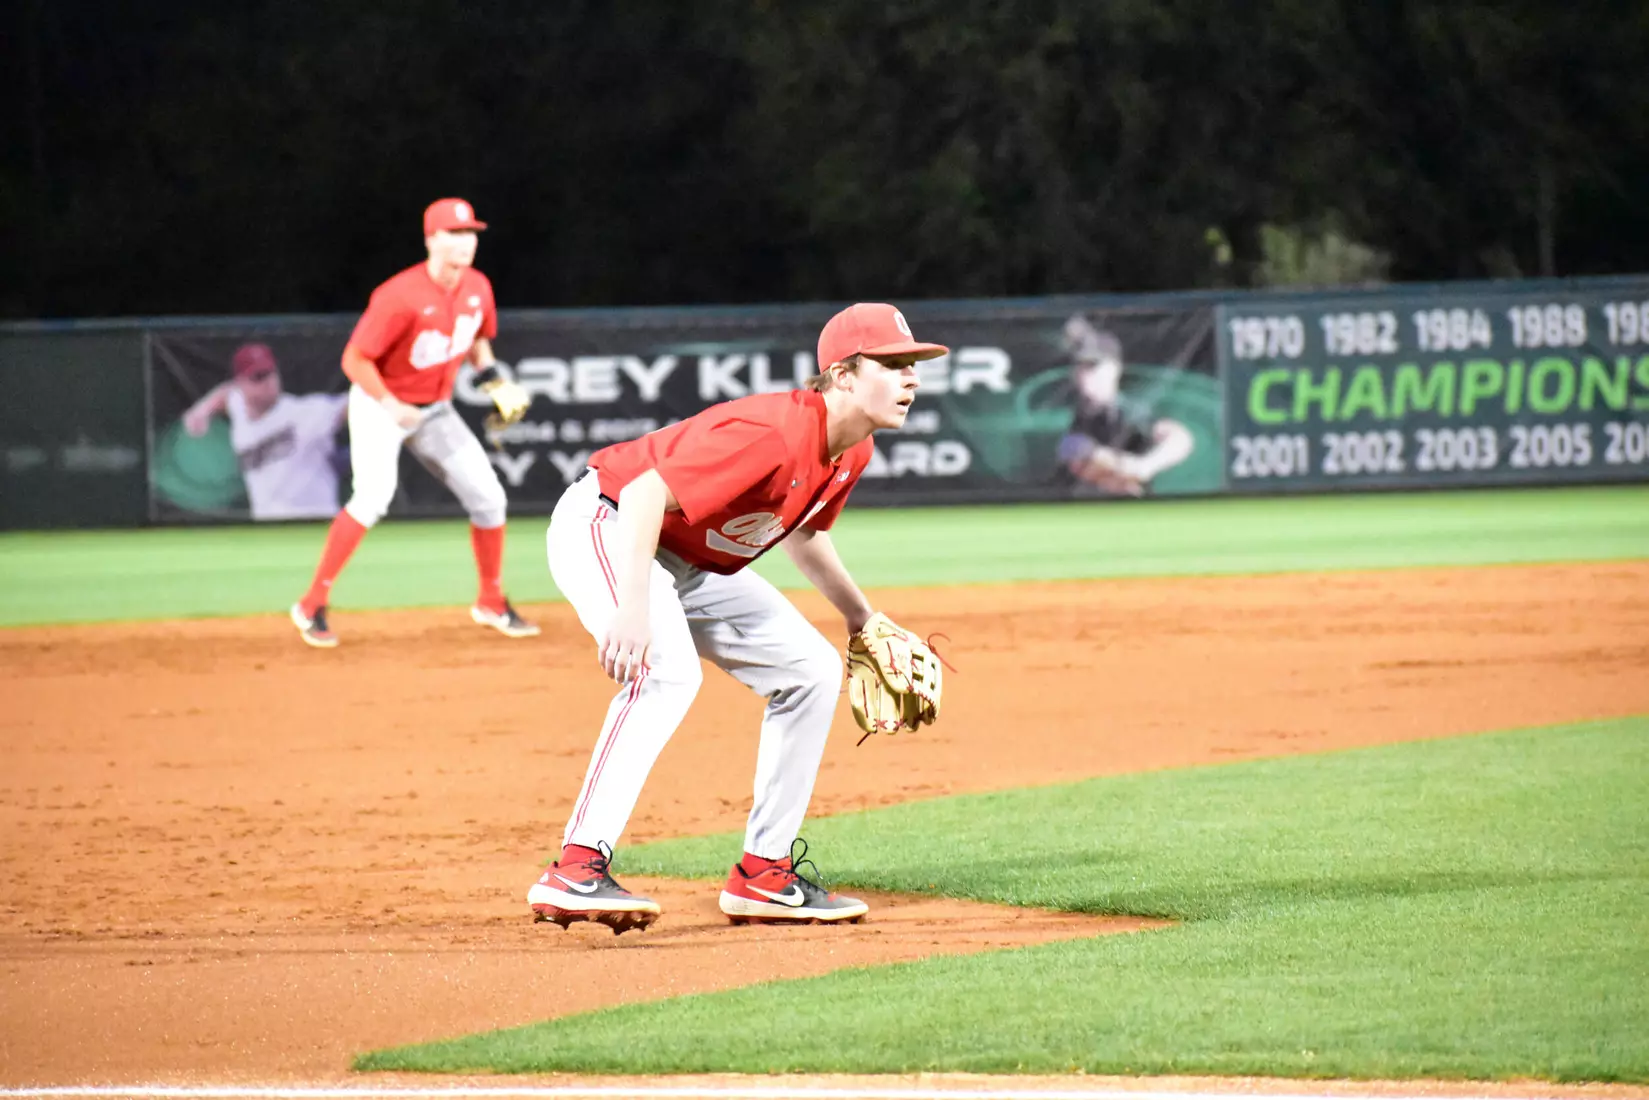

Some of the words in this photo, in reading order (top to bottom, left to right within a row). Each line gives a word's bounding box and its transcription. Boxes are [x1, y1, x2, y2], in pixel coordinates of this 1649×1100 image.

[1230, 316, 1305, 360] 1970
[1320, 311, 1398, 356] 1982
[1413, 307, 1493, 352] 1984
[1604, 302, 1649, 346] 198
[455, 355, 678, 405] OREY
[1232, 432, 1309, 477] 2001
[1323, 428, 1406, 475] 2002
[1415, 425, 1499, 472] 2003
[1509, 422, 1593, 468] 2005
[1604, 419, 1649, 464] 20
